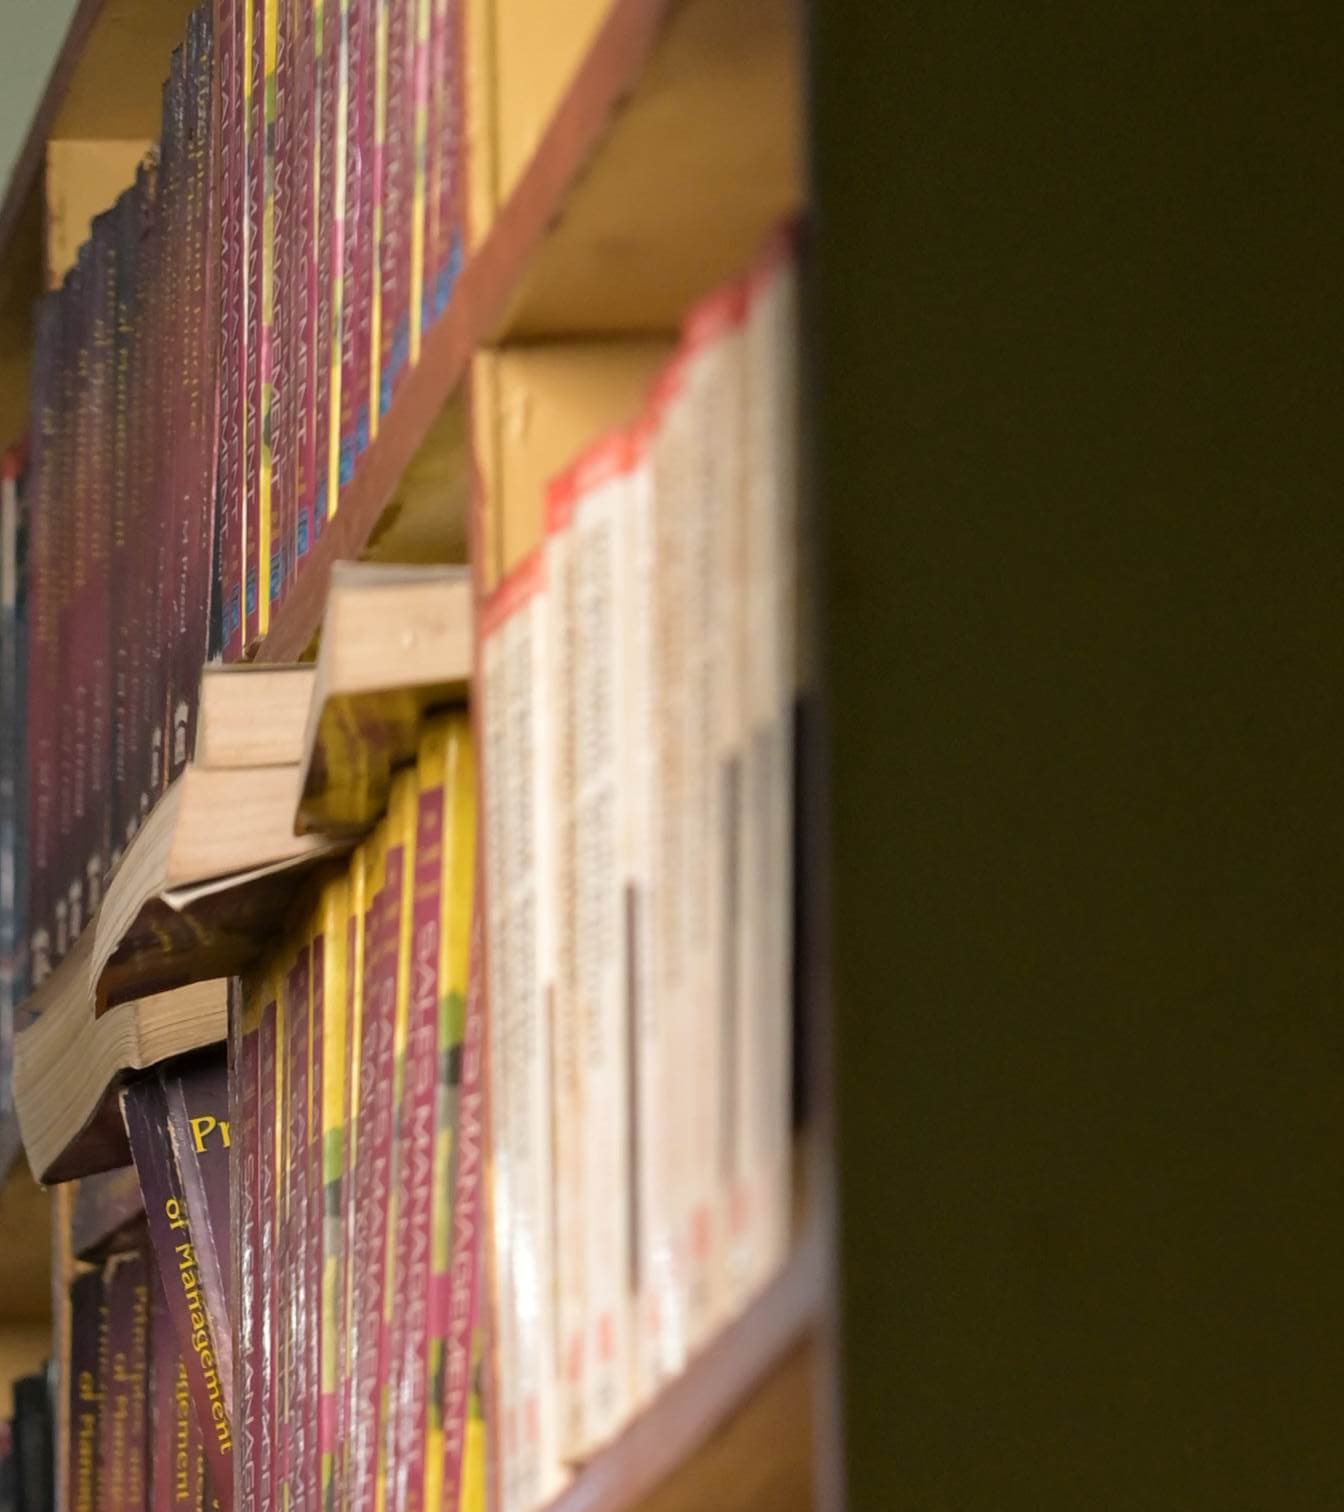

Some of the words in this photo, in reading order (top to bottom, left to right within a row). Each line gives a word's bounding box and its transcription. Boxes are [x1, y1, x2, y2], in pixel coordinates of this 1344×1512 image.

[272, 161, 284, 488] MANAGEMENT
[417, 921, 438, 1096] SALES
[165, 1197, 189, 1230] of
[175, 1243, 233, 1456] Management
